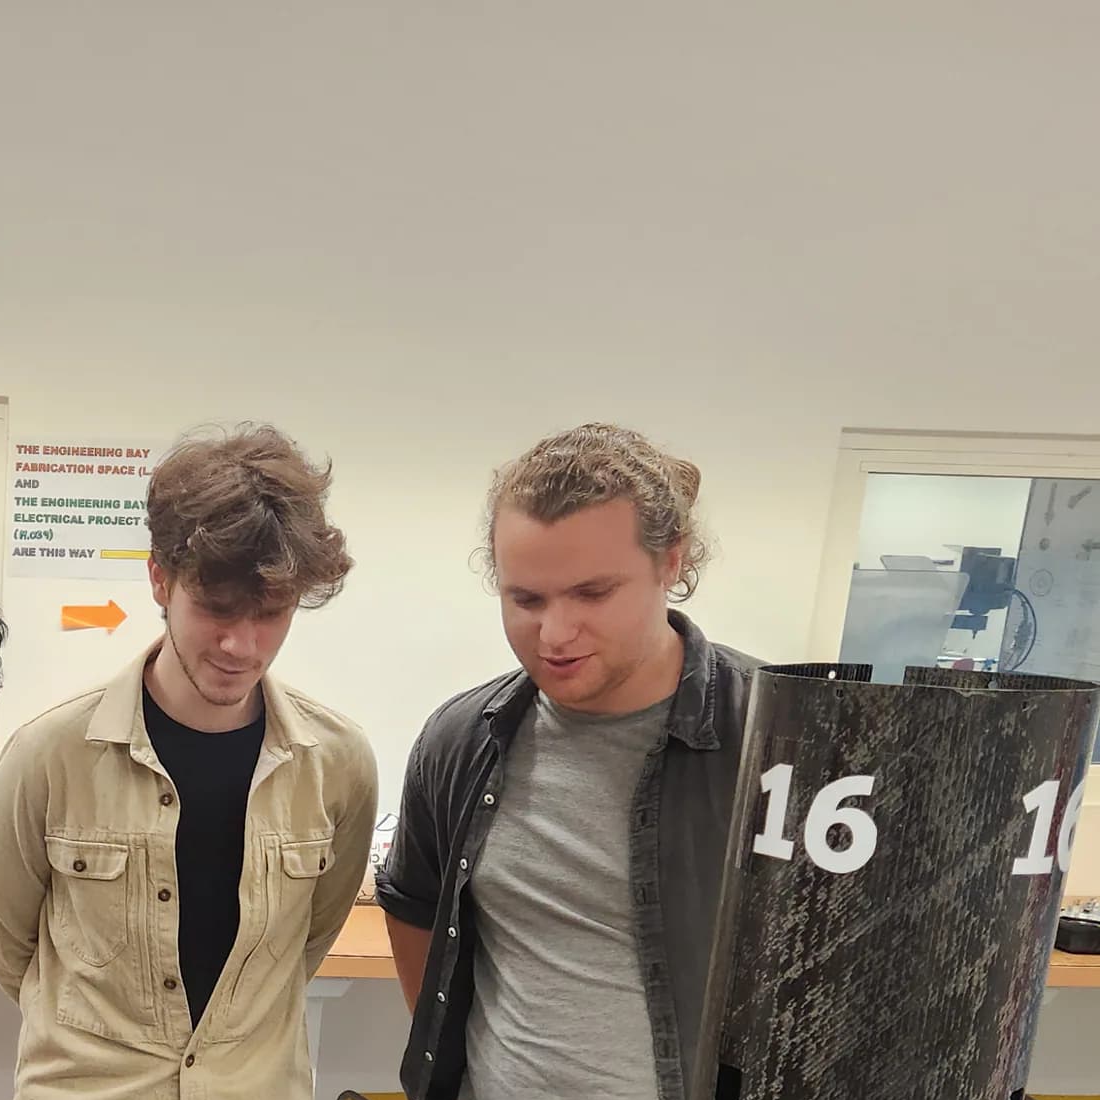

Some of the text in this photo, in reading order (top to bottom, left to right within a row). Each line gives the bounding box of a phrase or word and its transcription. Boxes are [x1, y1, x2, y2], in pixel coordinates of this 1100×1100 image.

[16, 445, 150, 458] THE ENGINEERING BAY
[15, 462, 94, 474] FABRICATION
[97, 465, 136, 475] SPACE
[14, 479, 40, 489] AND
[14, 497, 147, 510] THE ENGINEERING BAY
[13, 513, 85, 525] ELECTRICAL
[88, 515, 141, 526] PROJECT
[12, 547, 96, 559] ARE THIS WAY
[753, 763, 878, 874] 16
